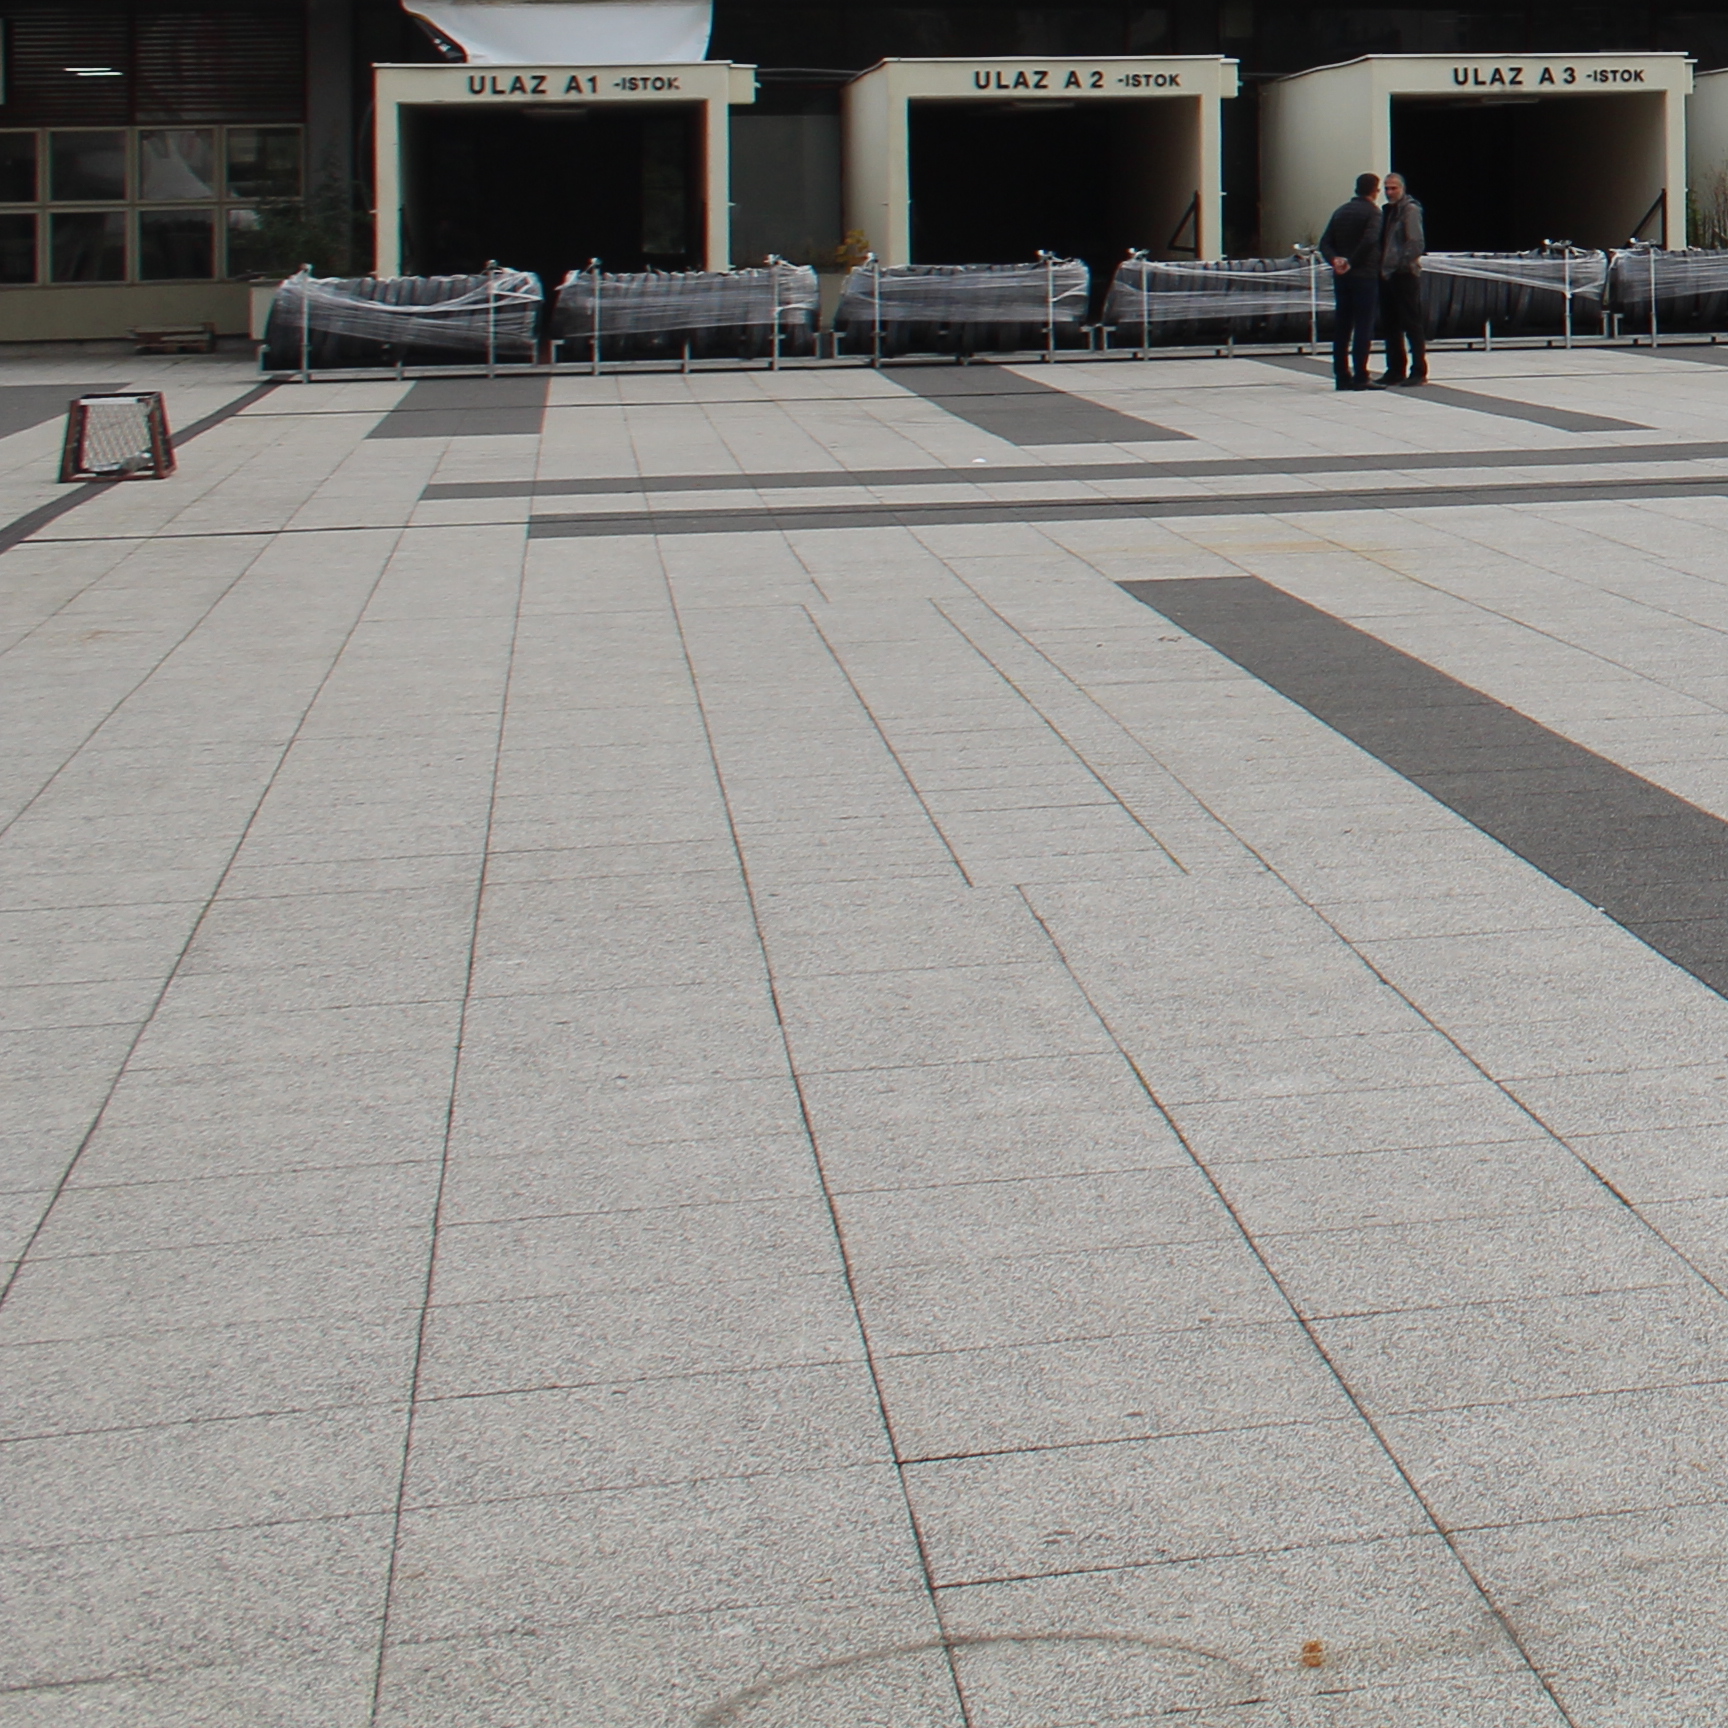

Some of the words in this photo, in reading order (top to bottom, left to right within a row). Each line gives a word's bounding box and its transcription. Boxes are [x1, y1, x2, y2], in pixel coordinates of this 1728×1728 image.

[467, 75, 549, 95] ULAZ
[564, 74, 599, 95] A1
[974, 70, 1049, 90] ULAZ
[1118, 73, 1182, 87] -ISTOK
[1453, 66, 1524, 86] ULAZ
[1585, 68, 1646, 83] -ISTOK
